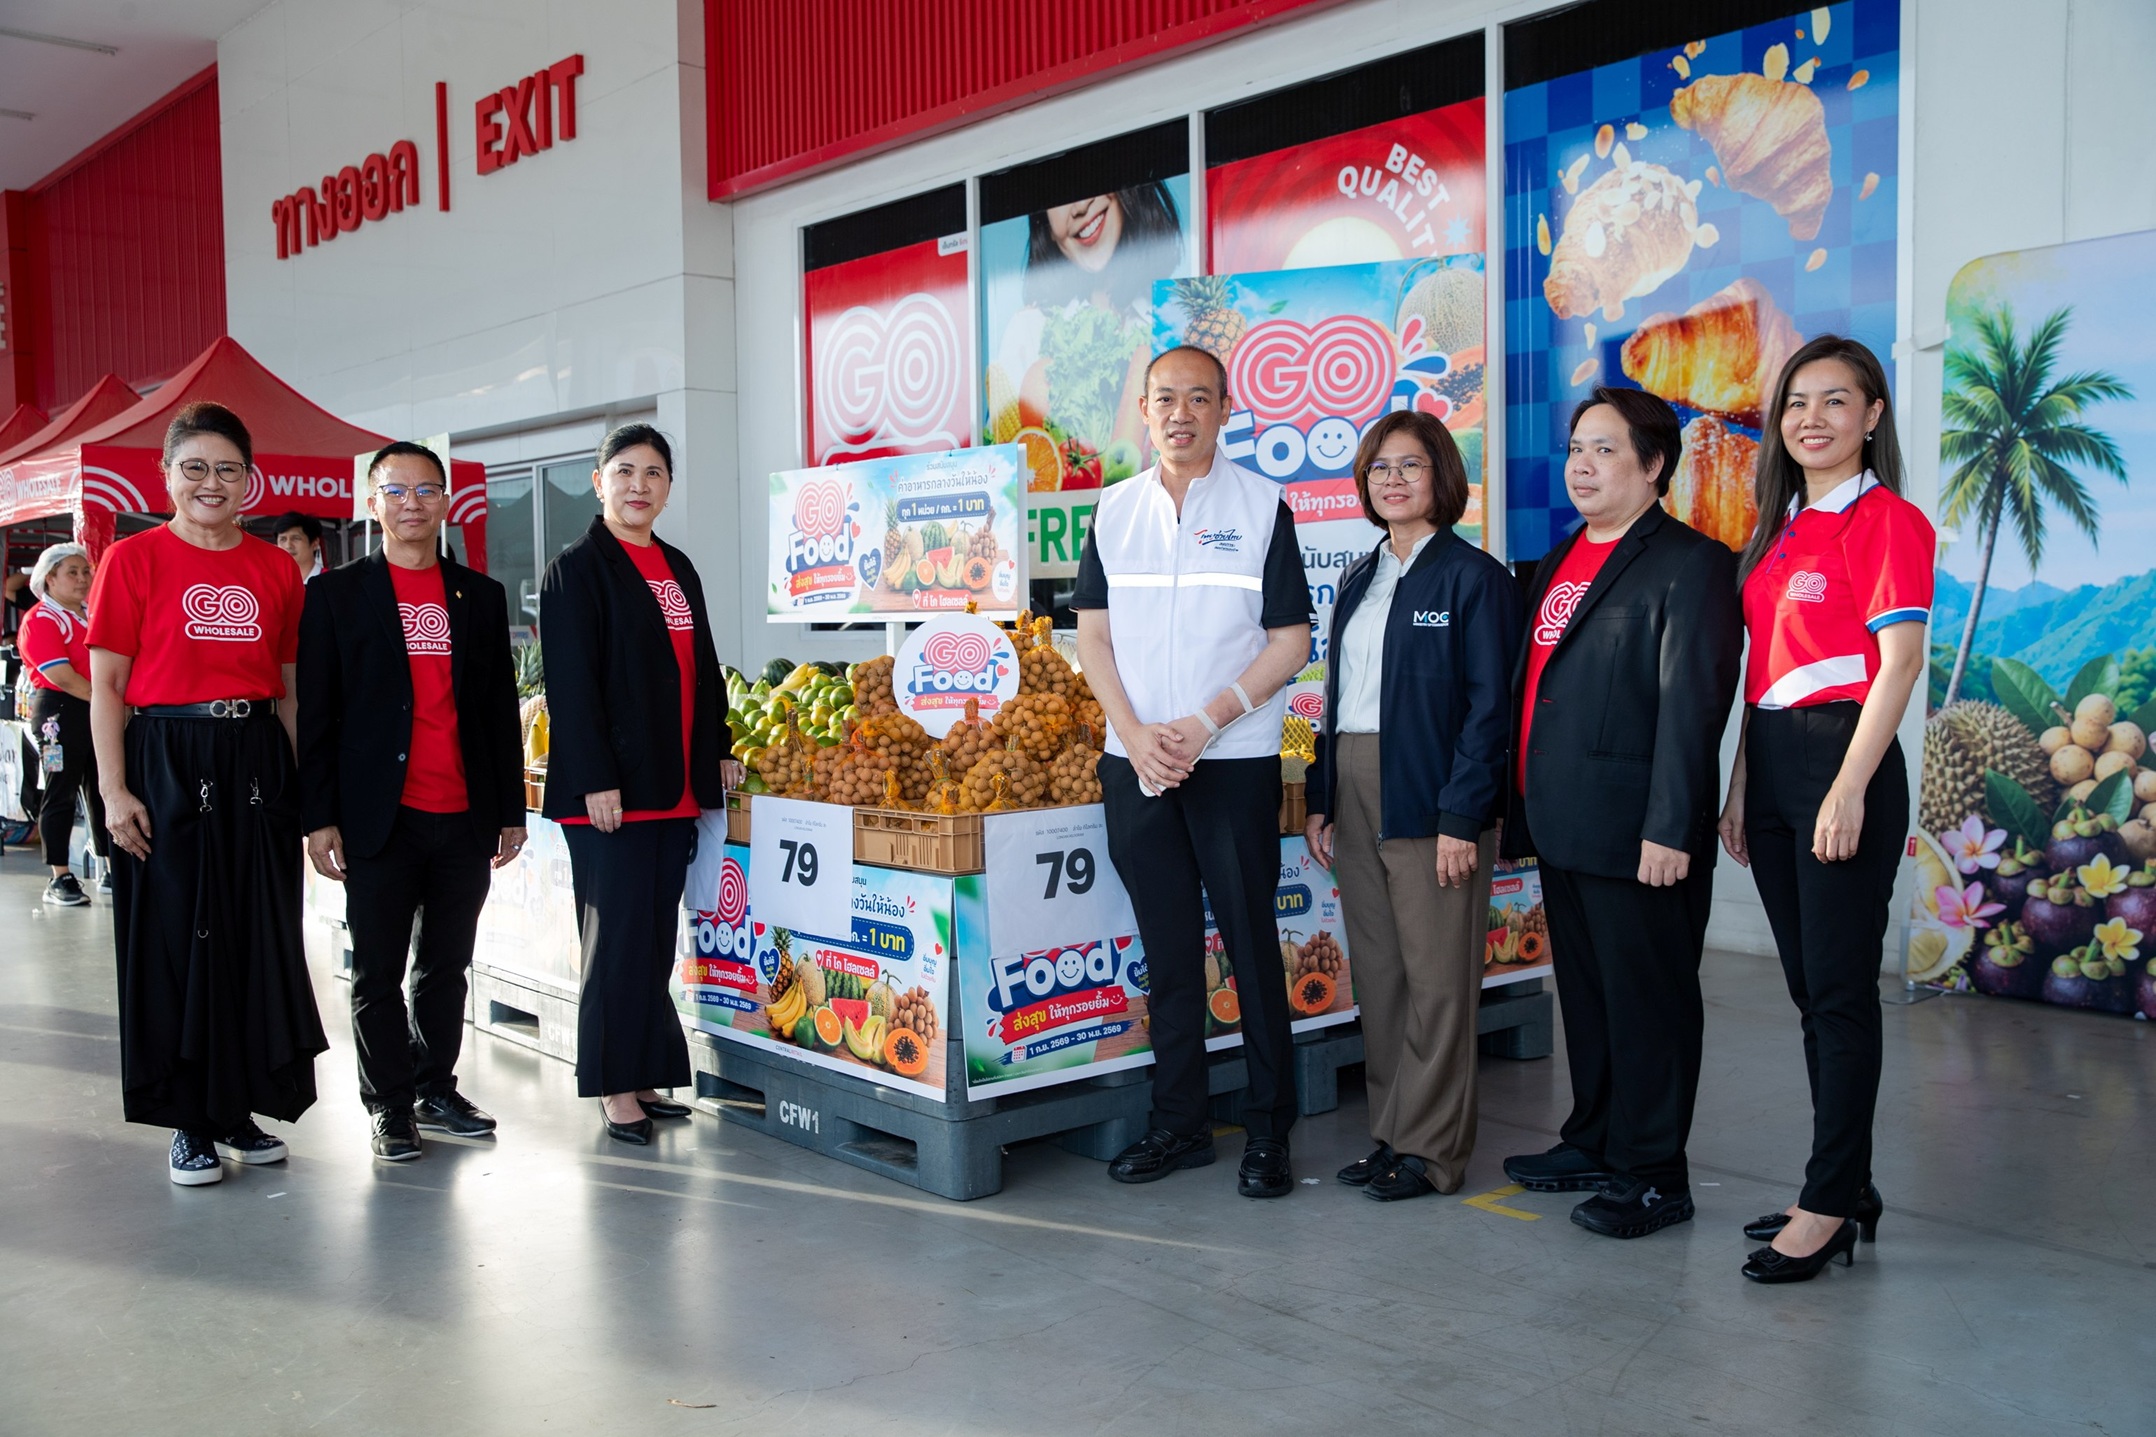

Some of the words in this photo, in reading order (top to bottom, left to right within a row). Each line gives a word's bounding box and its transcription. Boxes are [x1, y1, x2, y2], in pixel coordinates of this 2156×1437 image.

[476, 54, 584, 176] EXIT
[1385, 143, 1450, 210] BEST
[272, 139, 420, 260] ทางออก
[817, 292, 961, 446] GO
[1227, 315, 1397, 429] GO
[16, 475, 62, 502] WHOLESALE
[268, 475, 353, 499] WHOL
[898, 471, 989, 493] ค่าอาหารกลางวันให้น้อง
[795, 480, 845, 536] GO
[911, 502, 917, 516] 1
[957, 498, 964, 512] 1
[965, 498, 985, 511] บาท
[1290, 491, 1361, 517] ให้ทุกรอ
[788, 522, 850, 573] Food
[1788, 570, 1827, 594] GO
[183, 584, 259, 625] GO
[1413, 610, 1450, 623] MOC
[193, 625, 255, 637] WHOLESALE
[406, 642, 448, 651] OLESALE
[924, 632, 991, 673] GO
[913, 663, 995, 693] Food
[920, 695, 943, 708] ส่งสุข
[779, 839, 819, 887] 79
[1035, 848, 1096, 900] 79
[1276, 893, 1304, 910] บาท
[869, 927, 876, 946] 1
[880, 932, 905, 953] บาท
[708, 963, 747, 984] ให้ทุกรอยยิ้ม
[833, 956, 842, 971] โก
[843, 958, 876, 978] โฮลเซลล์
[993, 939, 1115, 1009] Food
[1012, 1009, 1047, 1031] ส่งสุข
[1048, 991, 1110, 1021] ให้ทุกรอยยิ้ม
[1029, 1047, 1034, 1055] 1
[1035, 1045, 1049, 1054] ก.ย.
[1050, 1036, 1070, 1049] 2569
[1076, 1032, 1087, 1042] 30
[1088, 1030, 1102, 1039] พ.ย.
[1102, 1024, 1122, 1035] 2569
[779, 1100, 820, 1135] CFW1
